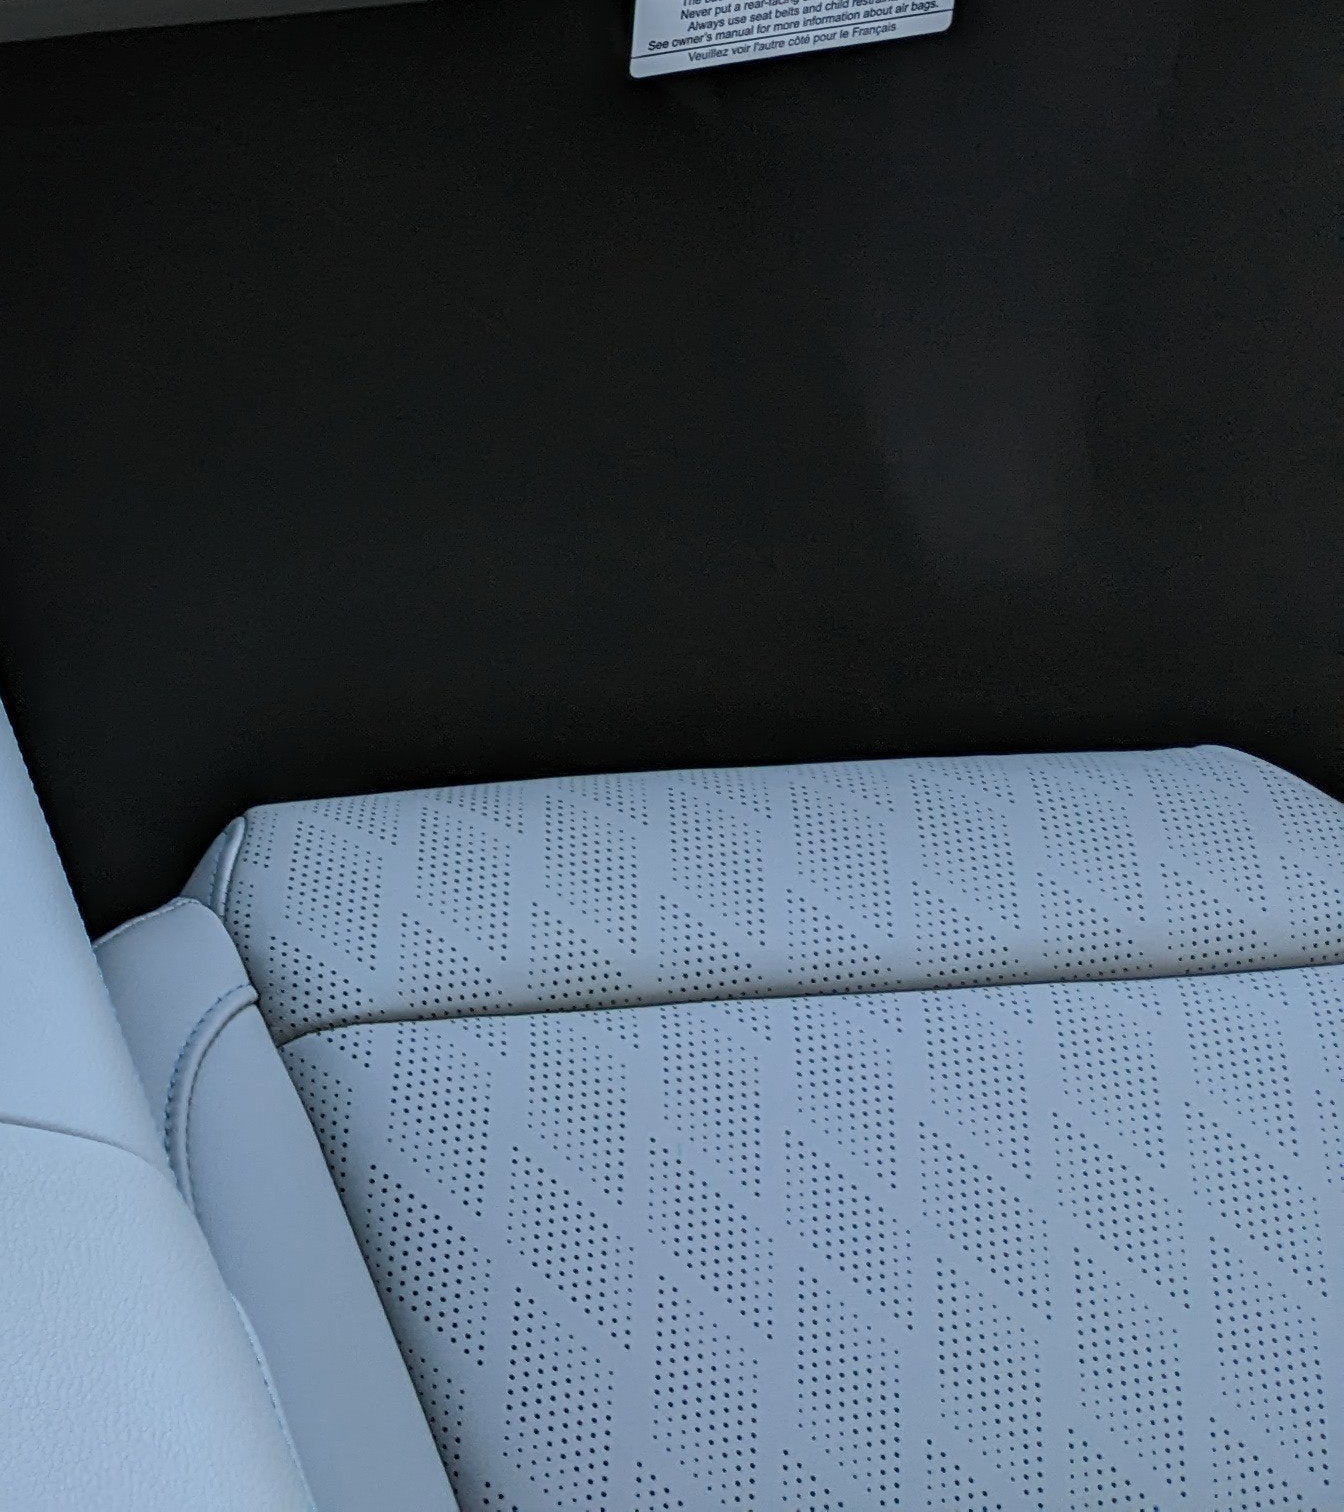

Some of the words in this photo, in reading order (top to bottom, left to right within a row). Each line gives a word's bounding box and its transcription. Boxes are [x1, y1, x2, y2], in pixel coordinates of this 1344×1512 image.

[648, 39, 669, 51] See
[671, 31, 712, 47] owner's
[715, 26, 754, 40] manual
[756, 22, 770, 34] for
[773, 20, 800, 31] more
[802, 10, 861, 27] information
[863, 5, 892, 19] about
[895, 2, 908, 14] air
[911, 0, 939, 12] bags.
[680, 6, 712, 20] Never
[714, 3, 731, 17] put
[733, 3, 741, 12] a
[687, 17, 725, 32] Always
[727, 15, 746, 25] use
[749, 10, 772, 22] seat
[774, 5, 799, 19] belts
[802, 3, 822, 15] and
[825, 0, 849, 11] child
[688, 48, 728, 62] Veuillez
[731, 44, 750, 55] voir
[753, 38, 785, 52] l'autre
[788, 33, 810, 47] côté
[813, 31, 837, 45] pour
[839, 28, 849, 39] le
[852, 23, 897, 39] Français
